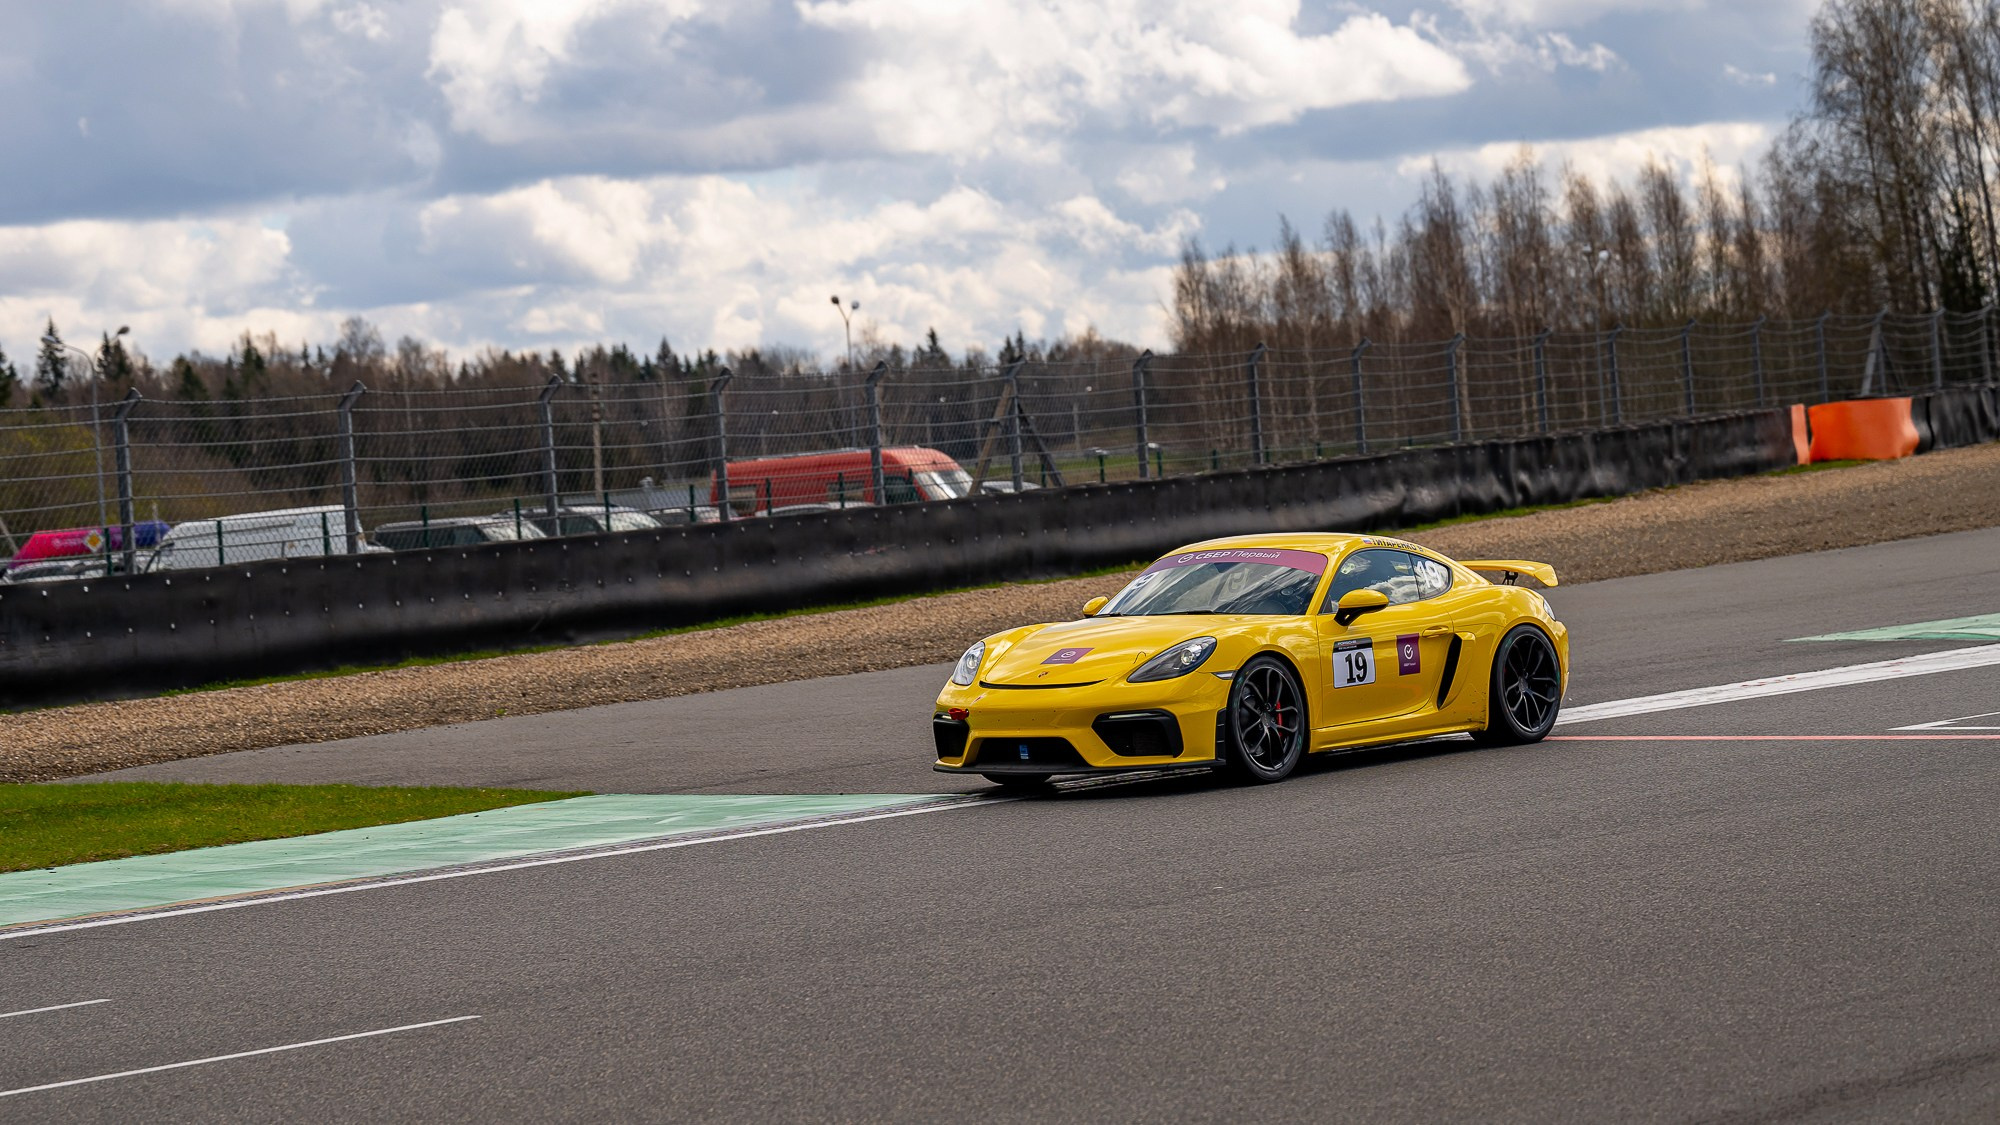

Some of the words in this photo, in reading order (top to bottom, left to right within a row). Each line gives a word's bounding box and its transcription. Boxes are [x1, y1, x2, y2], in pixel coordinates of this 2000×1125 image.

[1195, 551, 1231, 560] СБЕР
[1231, 550, 1282, 559] Первый
[1414, 560, 1444, 589] 19
[1344, 651, 1368, 684] 19
